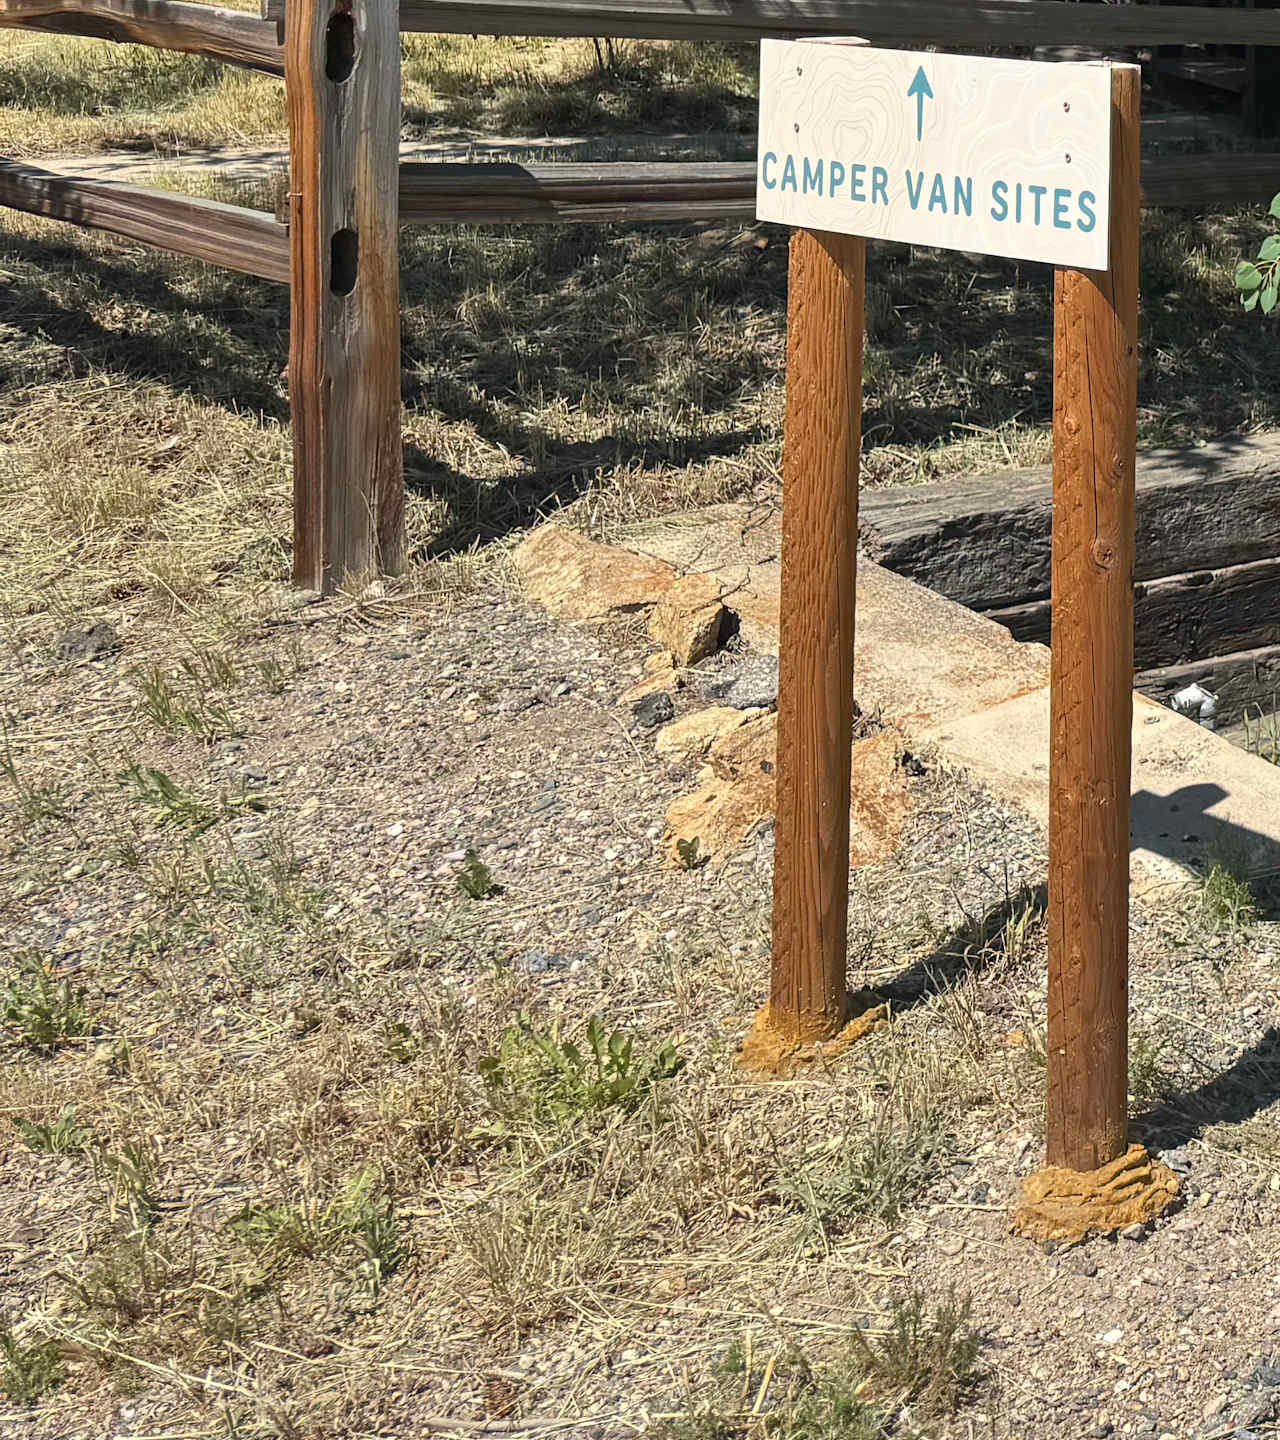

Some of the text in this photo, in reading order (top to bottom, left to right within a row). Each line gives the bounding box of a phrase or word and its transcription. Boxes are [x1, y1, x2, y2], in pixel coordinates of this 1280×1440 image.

[762, 151, 1096, 233] CAMPER VAN SITES
